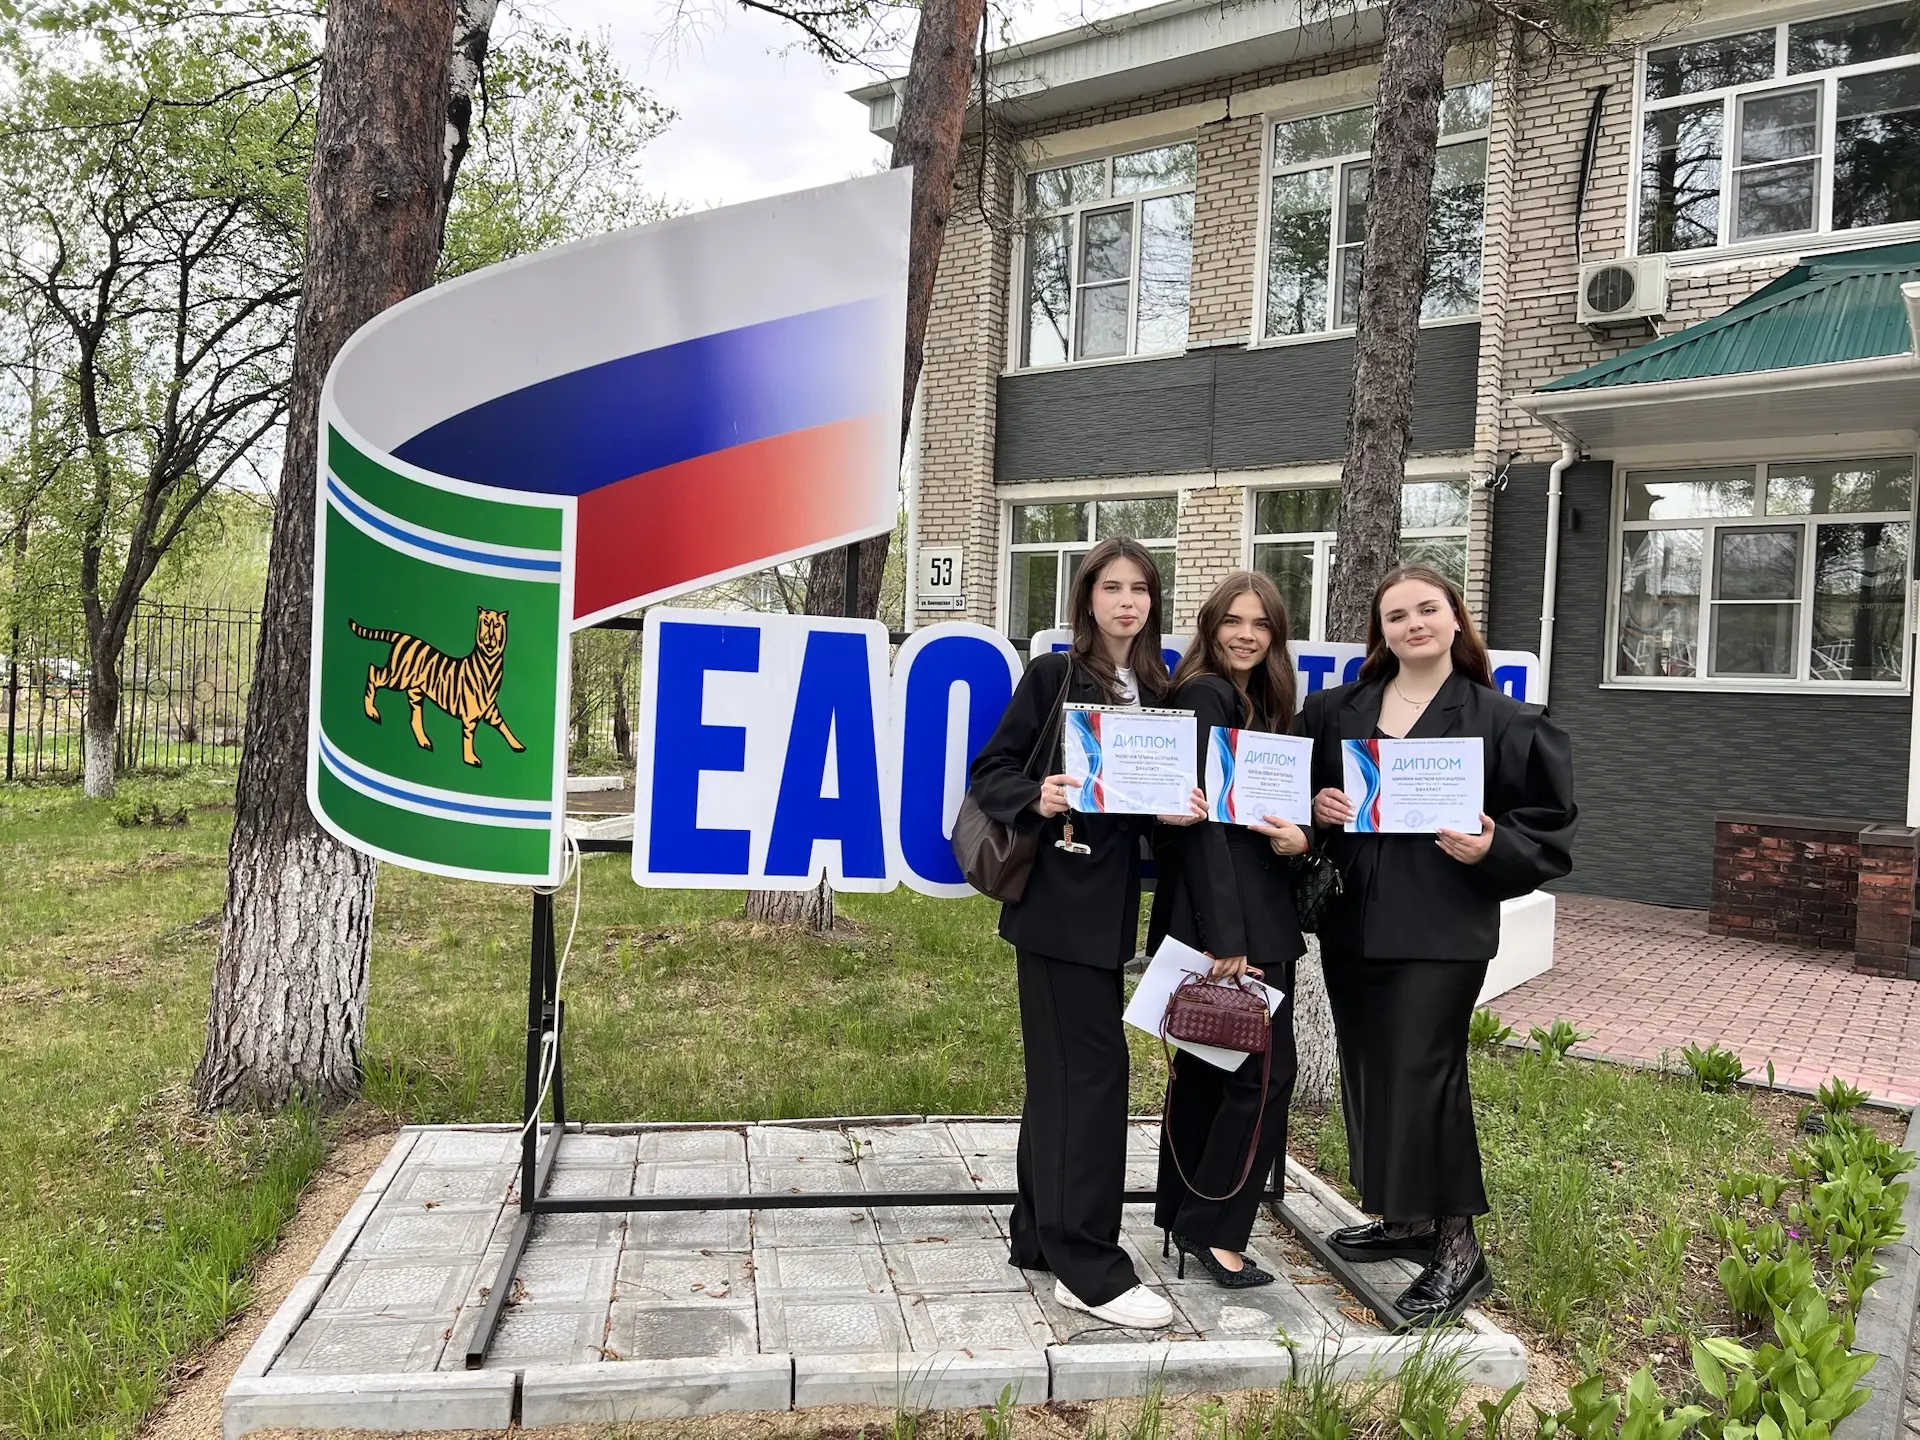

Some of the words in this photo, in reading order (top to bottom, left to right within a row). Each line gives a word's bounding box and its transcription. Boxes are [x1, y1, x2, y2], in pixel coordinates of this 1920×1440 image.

[931, 558, 952, 586] 53
[1113, 734, 1176, 749] ДИПЛОМ
[648, 622, 1012, 884] ЕАО
[1244, 751, 1296, 767] ДИПЛОМ
[1392, 758, 1461, 771] ДИПЛОМ
